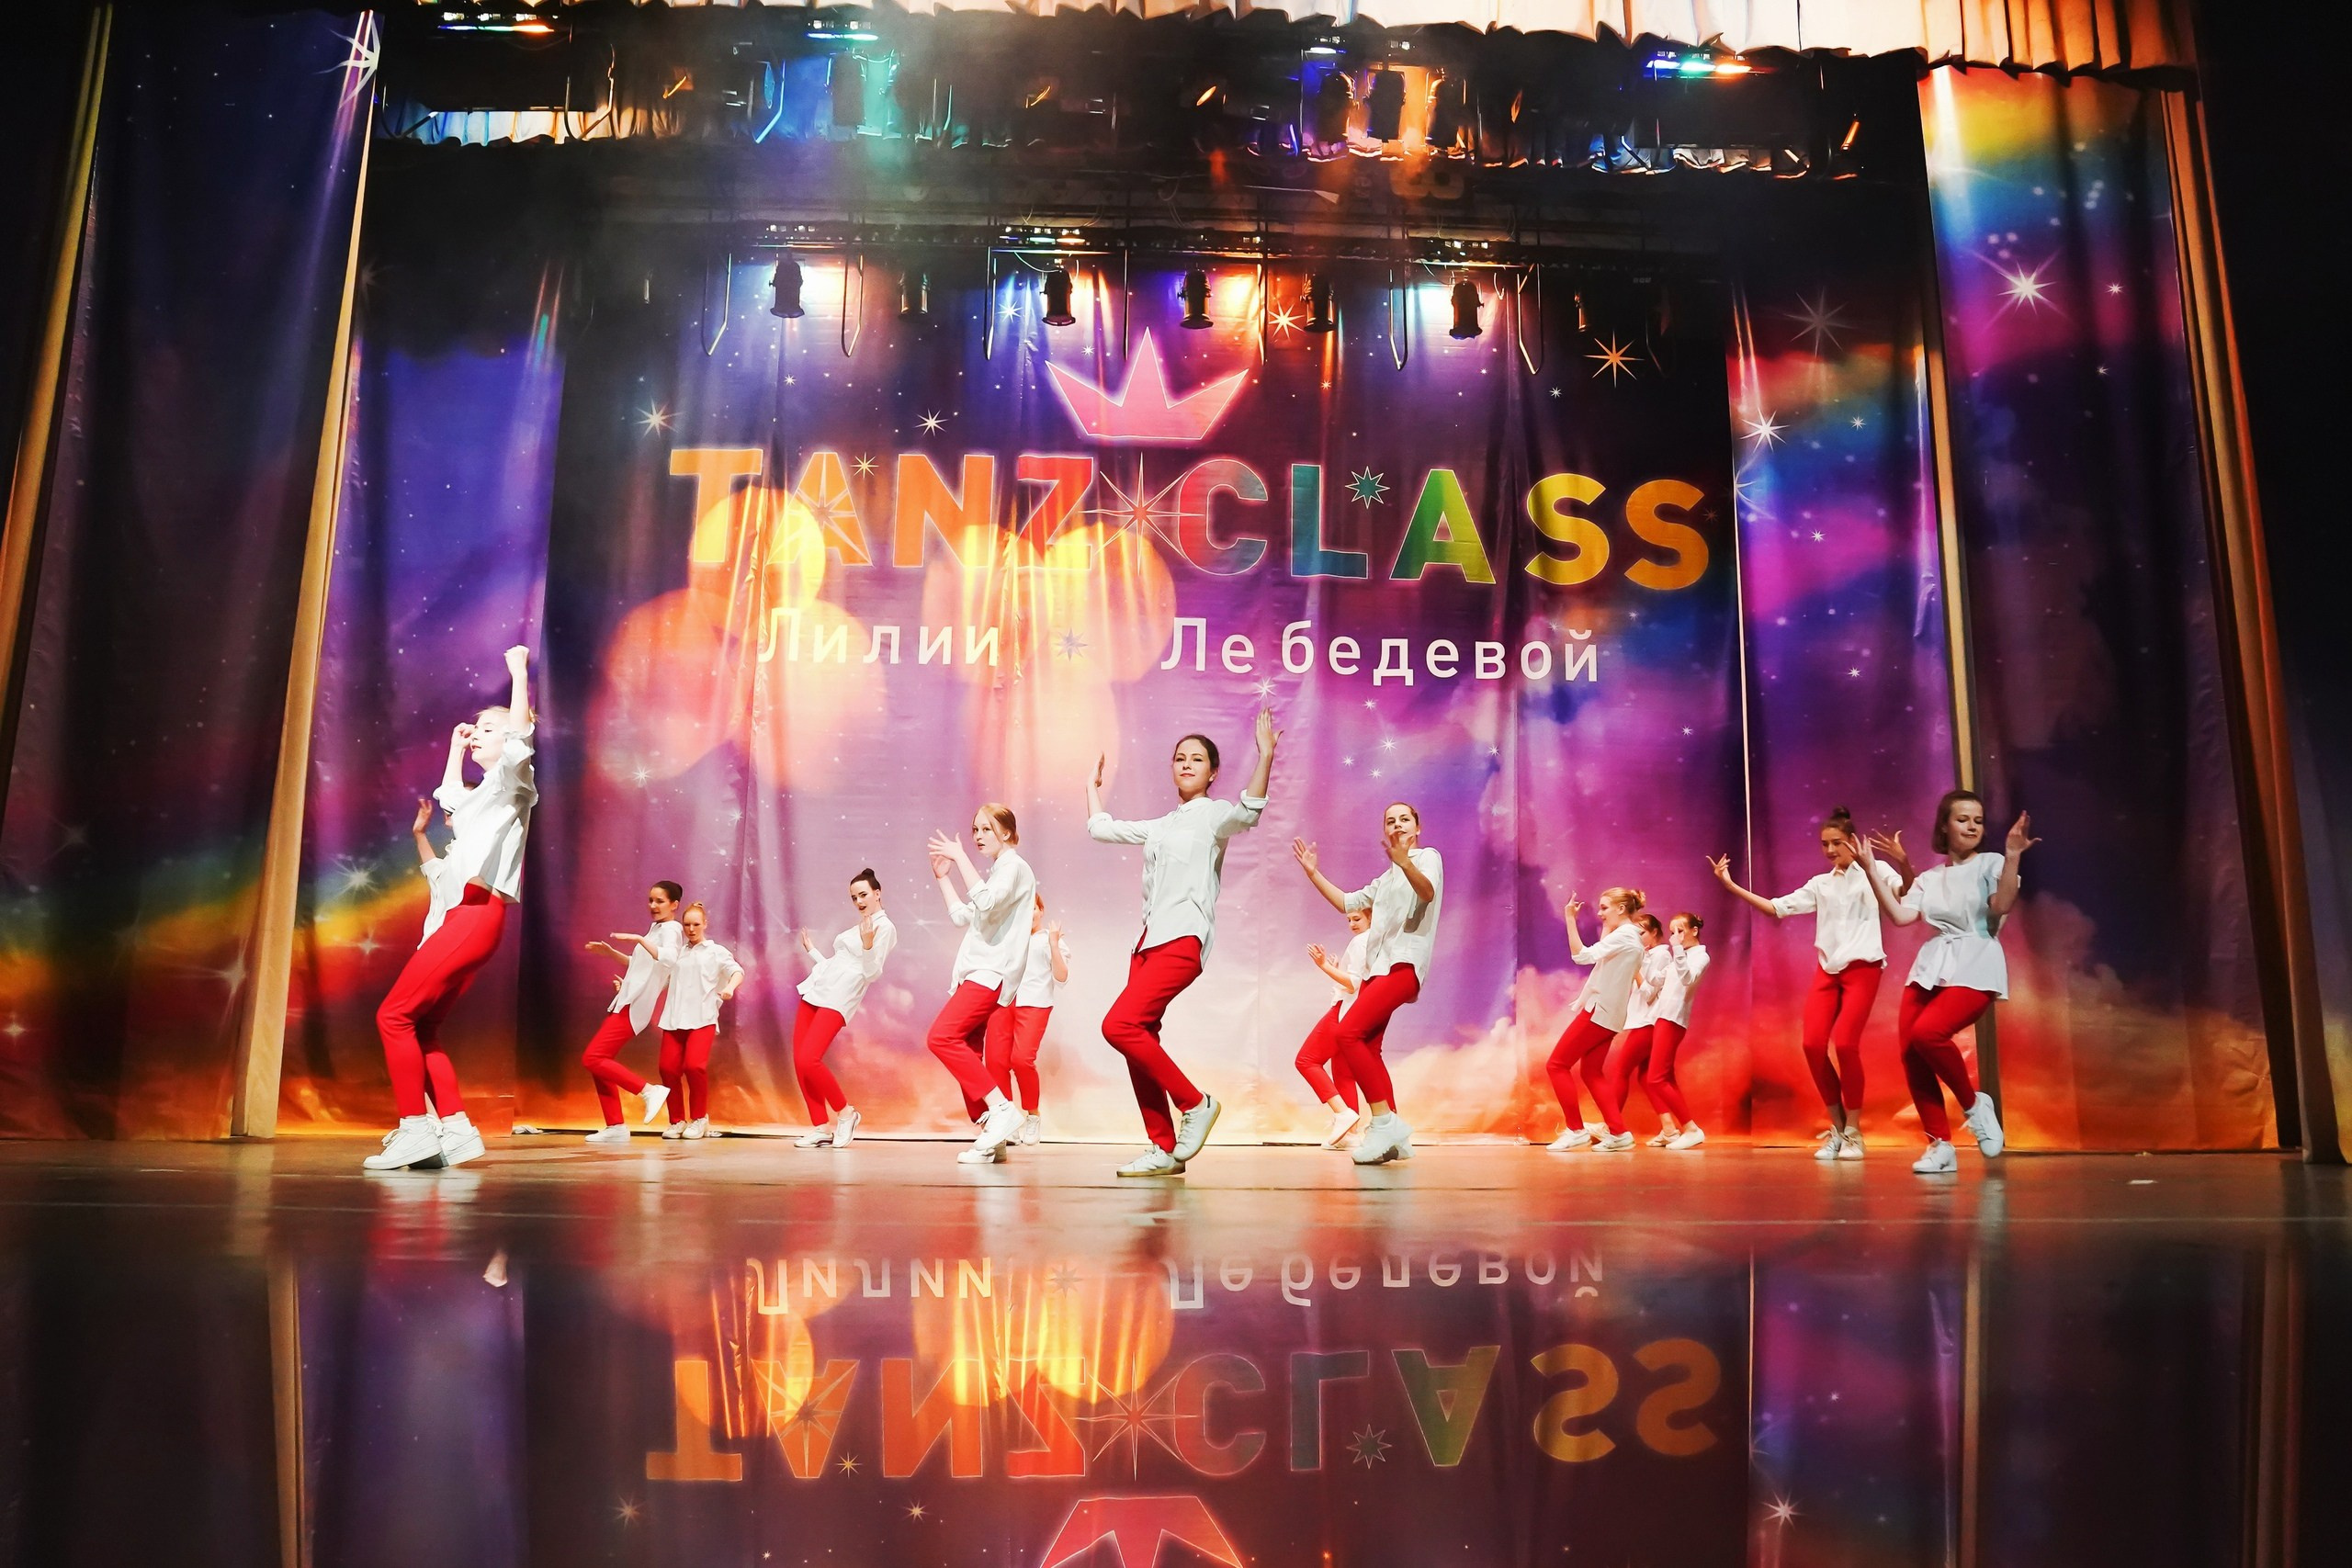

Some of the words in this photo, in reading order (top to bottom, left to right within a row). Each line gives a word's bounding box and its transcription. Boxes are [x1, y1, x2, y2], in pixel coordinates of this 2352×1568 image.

[670, 448, 1094, 571] TANZ
[1177, 459, 1710, 591] CLASS
[758, 607, 1000, 666] Лилии
[1161, 616, 1599, 686] Лебедевой
